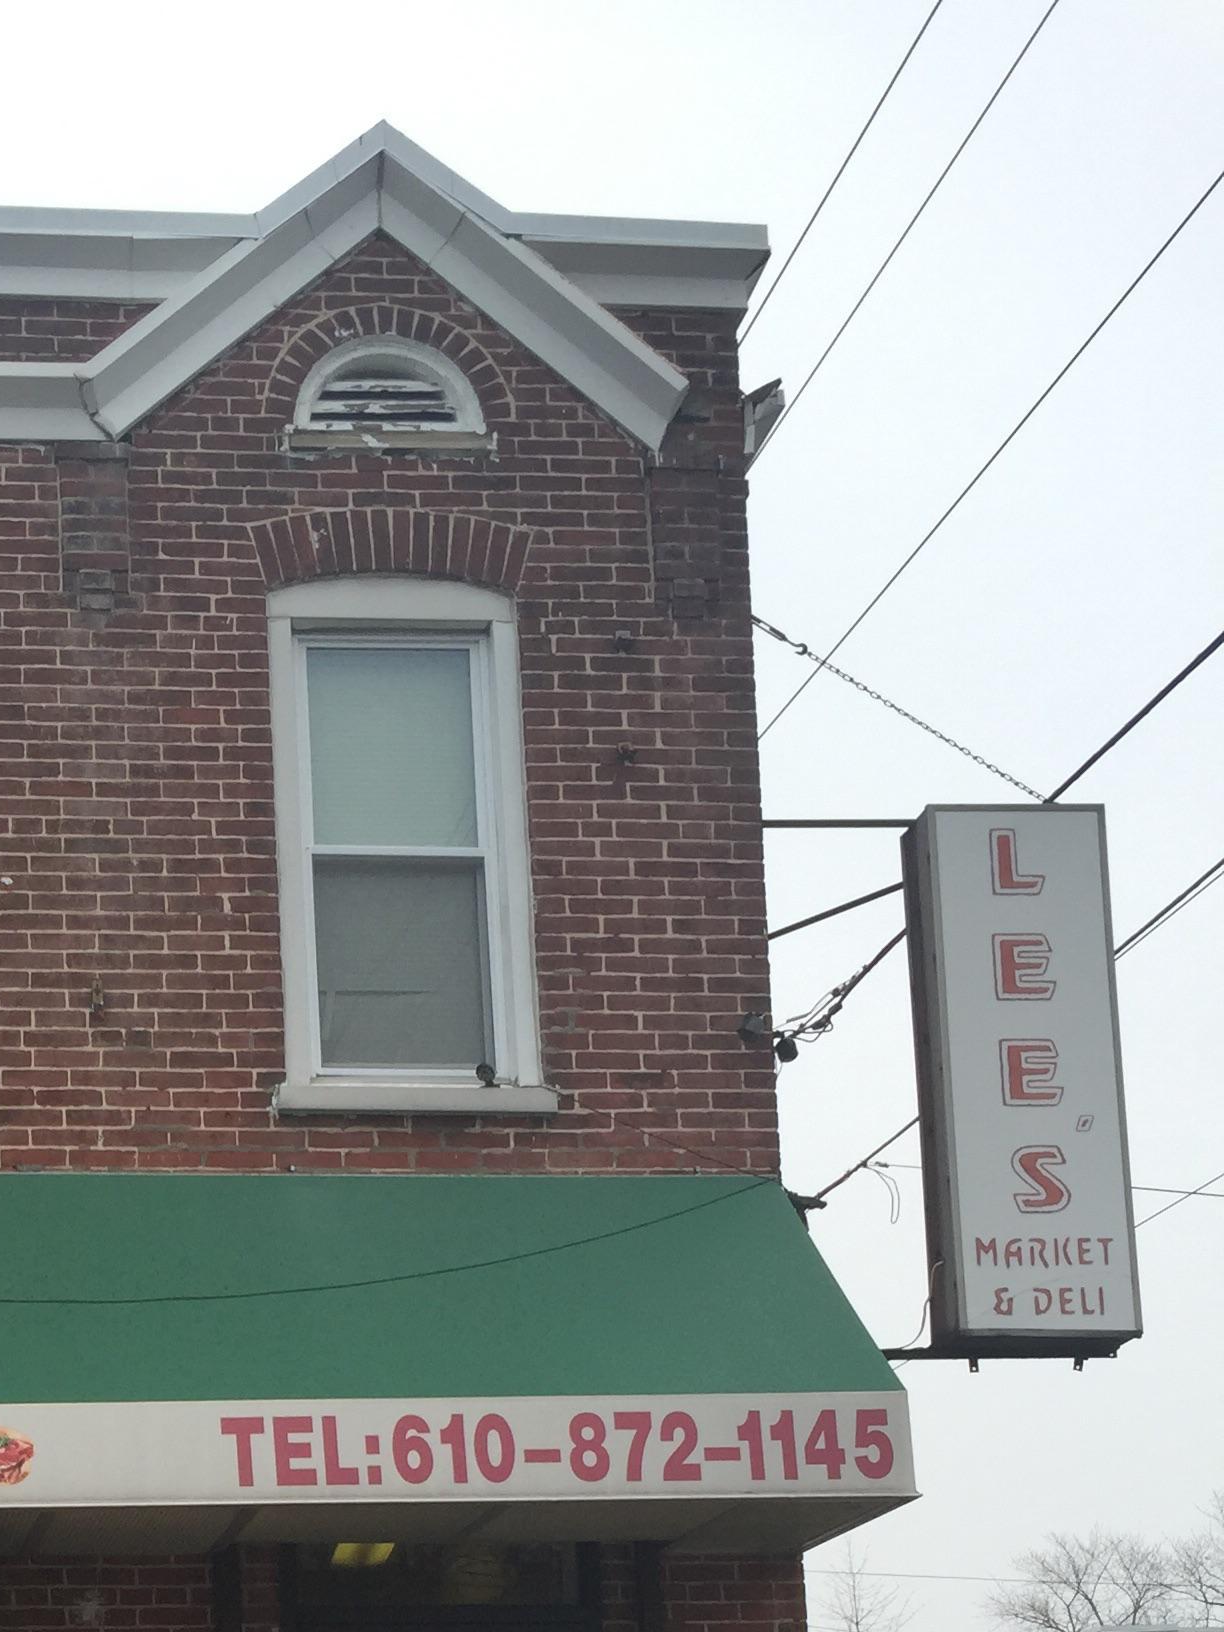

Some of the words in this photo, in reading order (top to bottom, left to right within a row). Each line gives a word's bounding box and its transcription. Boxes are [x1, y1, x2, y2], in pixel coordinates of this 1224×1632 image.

[975, 1237, 1113, 1268] MARKET
[993, 1286, 1014, 1316] &
[1032, 1286, 1106, 1316] DELI
